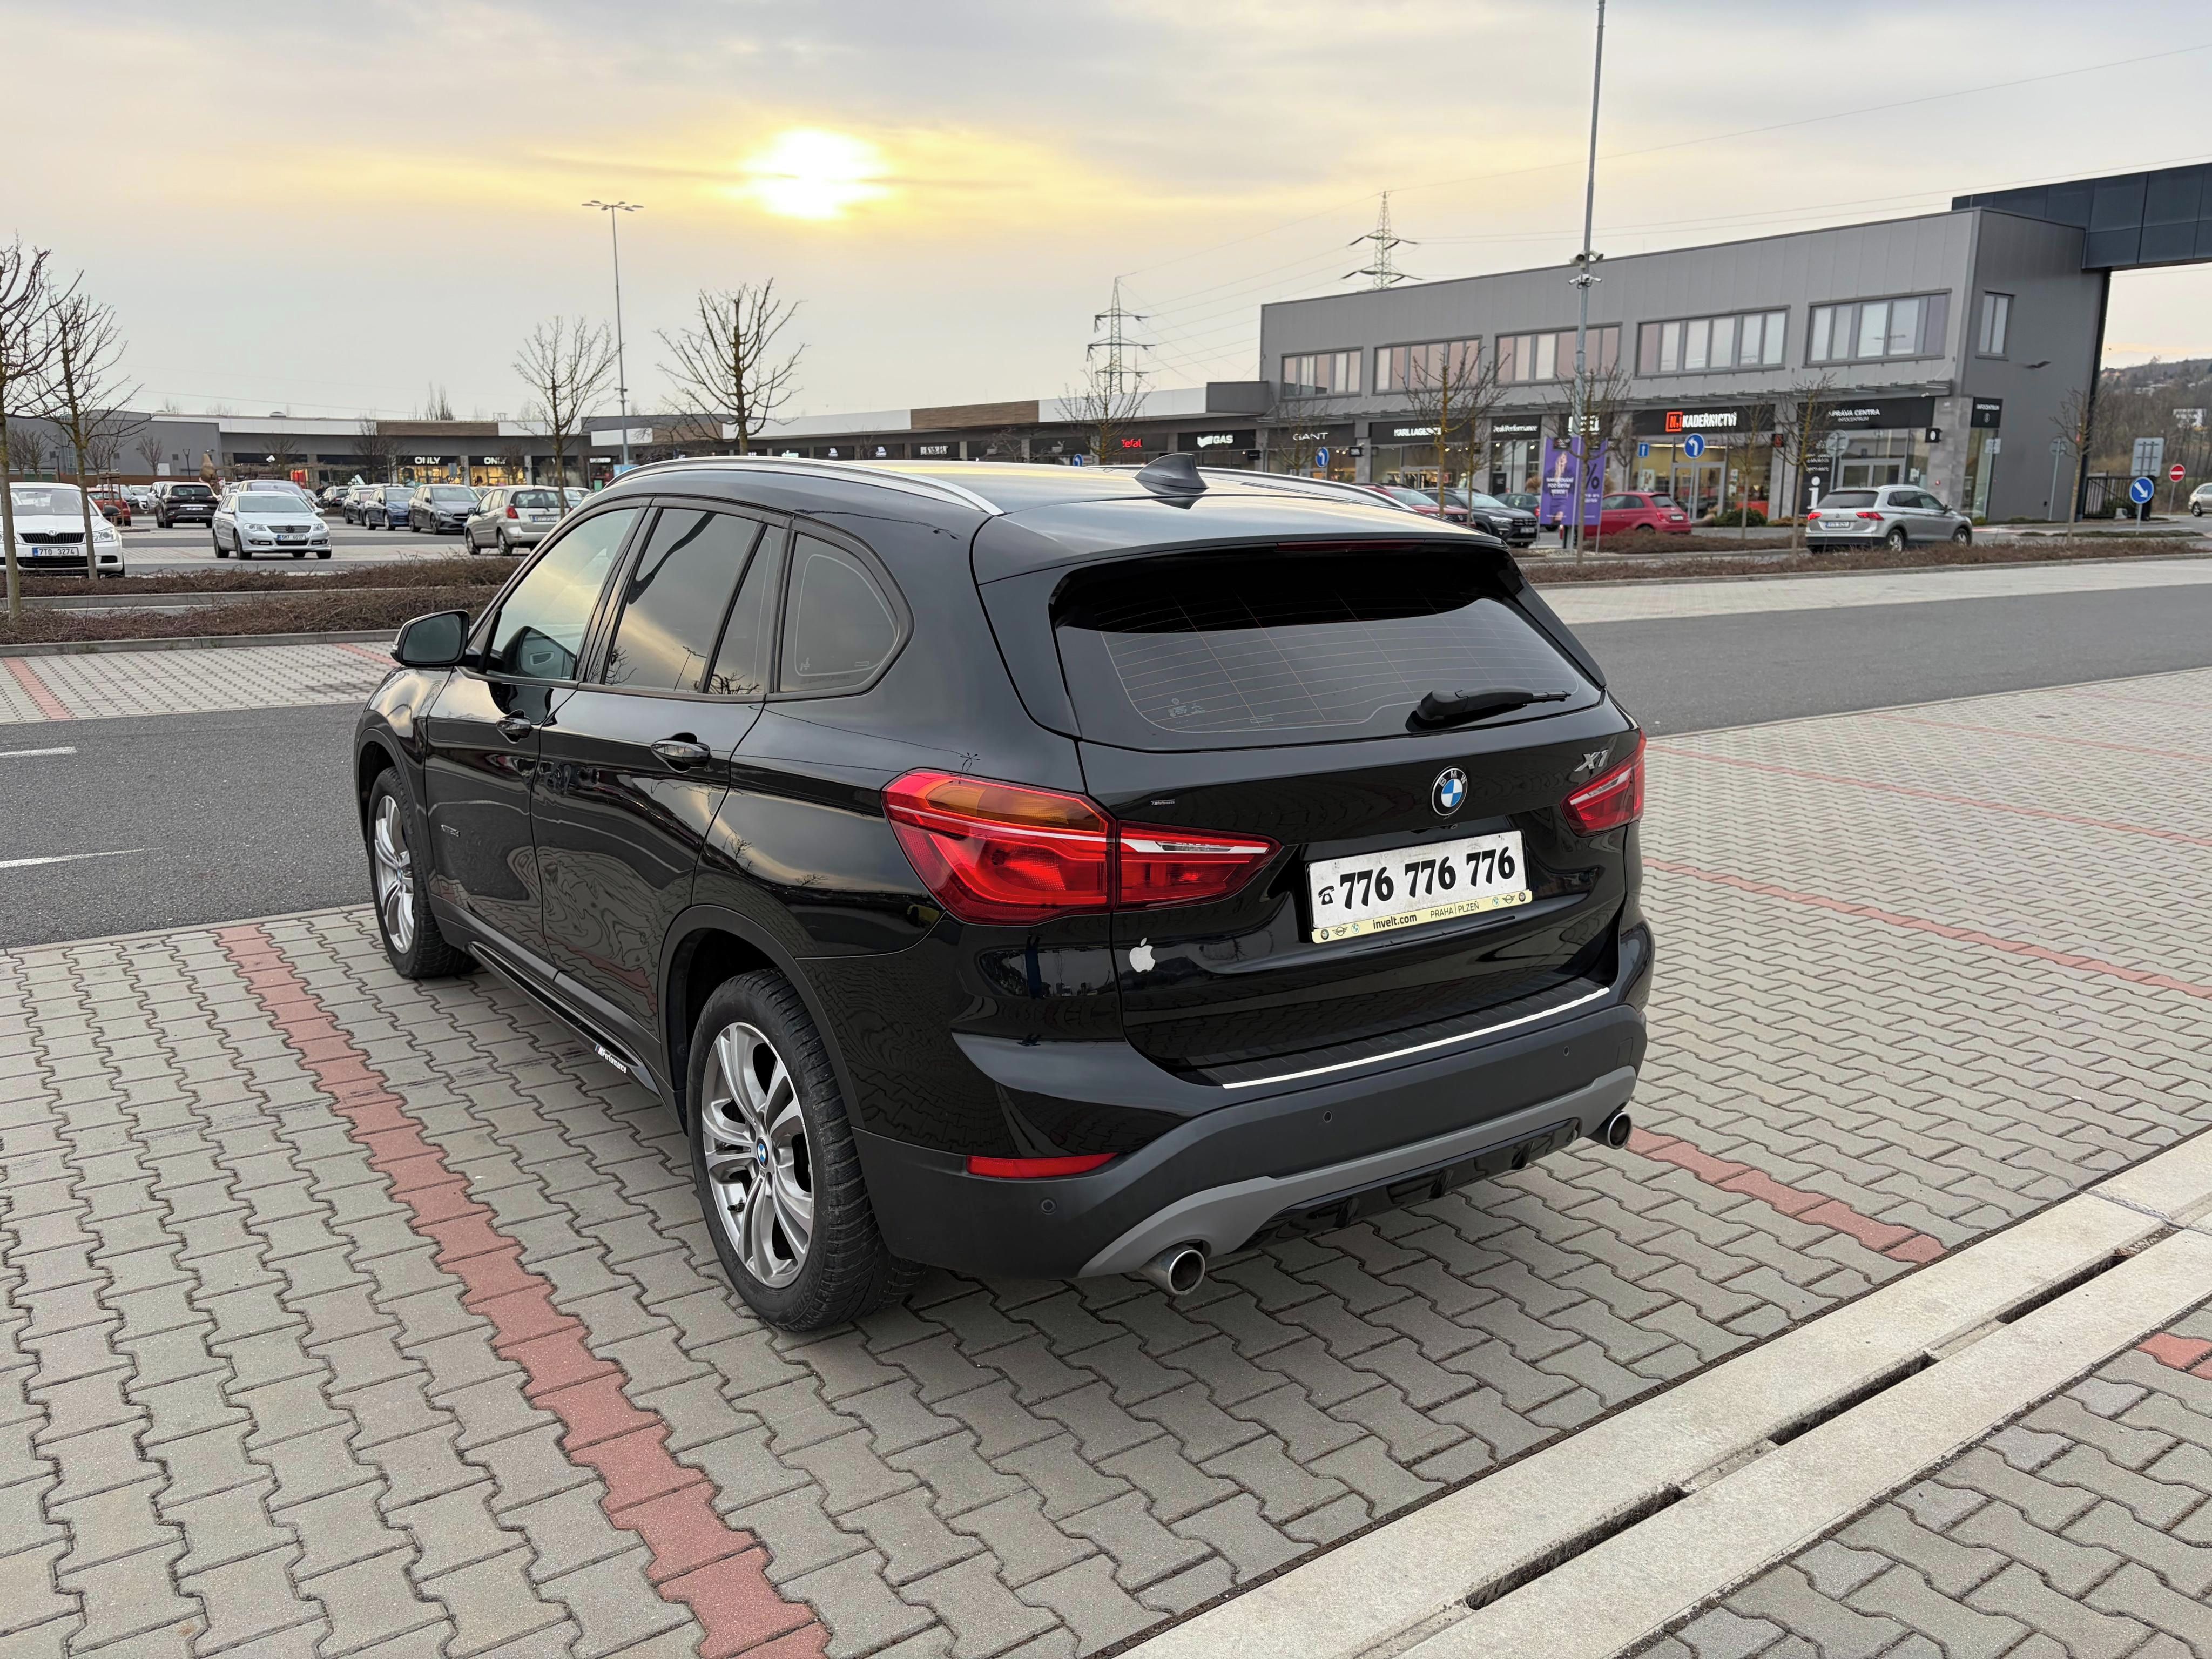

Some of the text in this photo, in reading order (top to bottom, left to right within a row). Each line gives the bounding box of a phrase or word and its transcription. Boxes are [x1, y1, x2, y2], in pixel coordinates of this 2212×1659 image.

[1682, 412, 1737, 428] KADEŘNICTVÍ
[1121, 438, 1143, 448] Tefal
[1213, 435, 1233, 444] GAS
[1292, 432, 1328, 441] GANT
[1574, 749, 1609, 772] X1
[1438, 770, 1467, 787] BMW
[1340, 846, 1515, 909] 776 776 776
[1373, 900, 1480, 929] invelt.com PRAHA PLZEŇ
